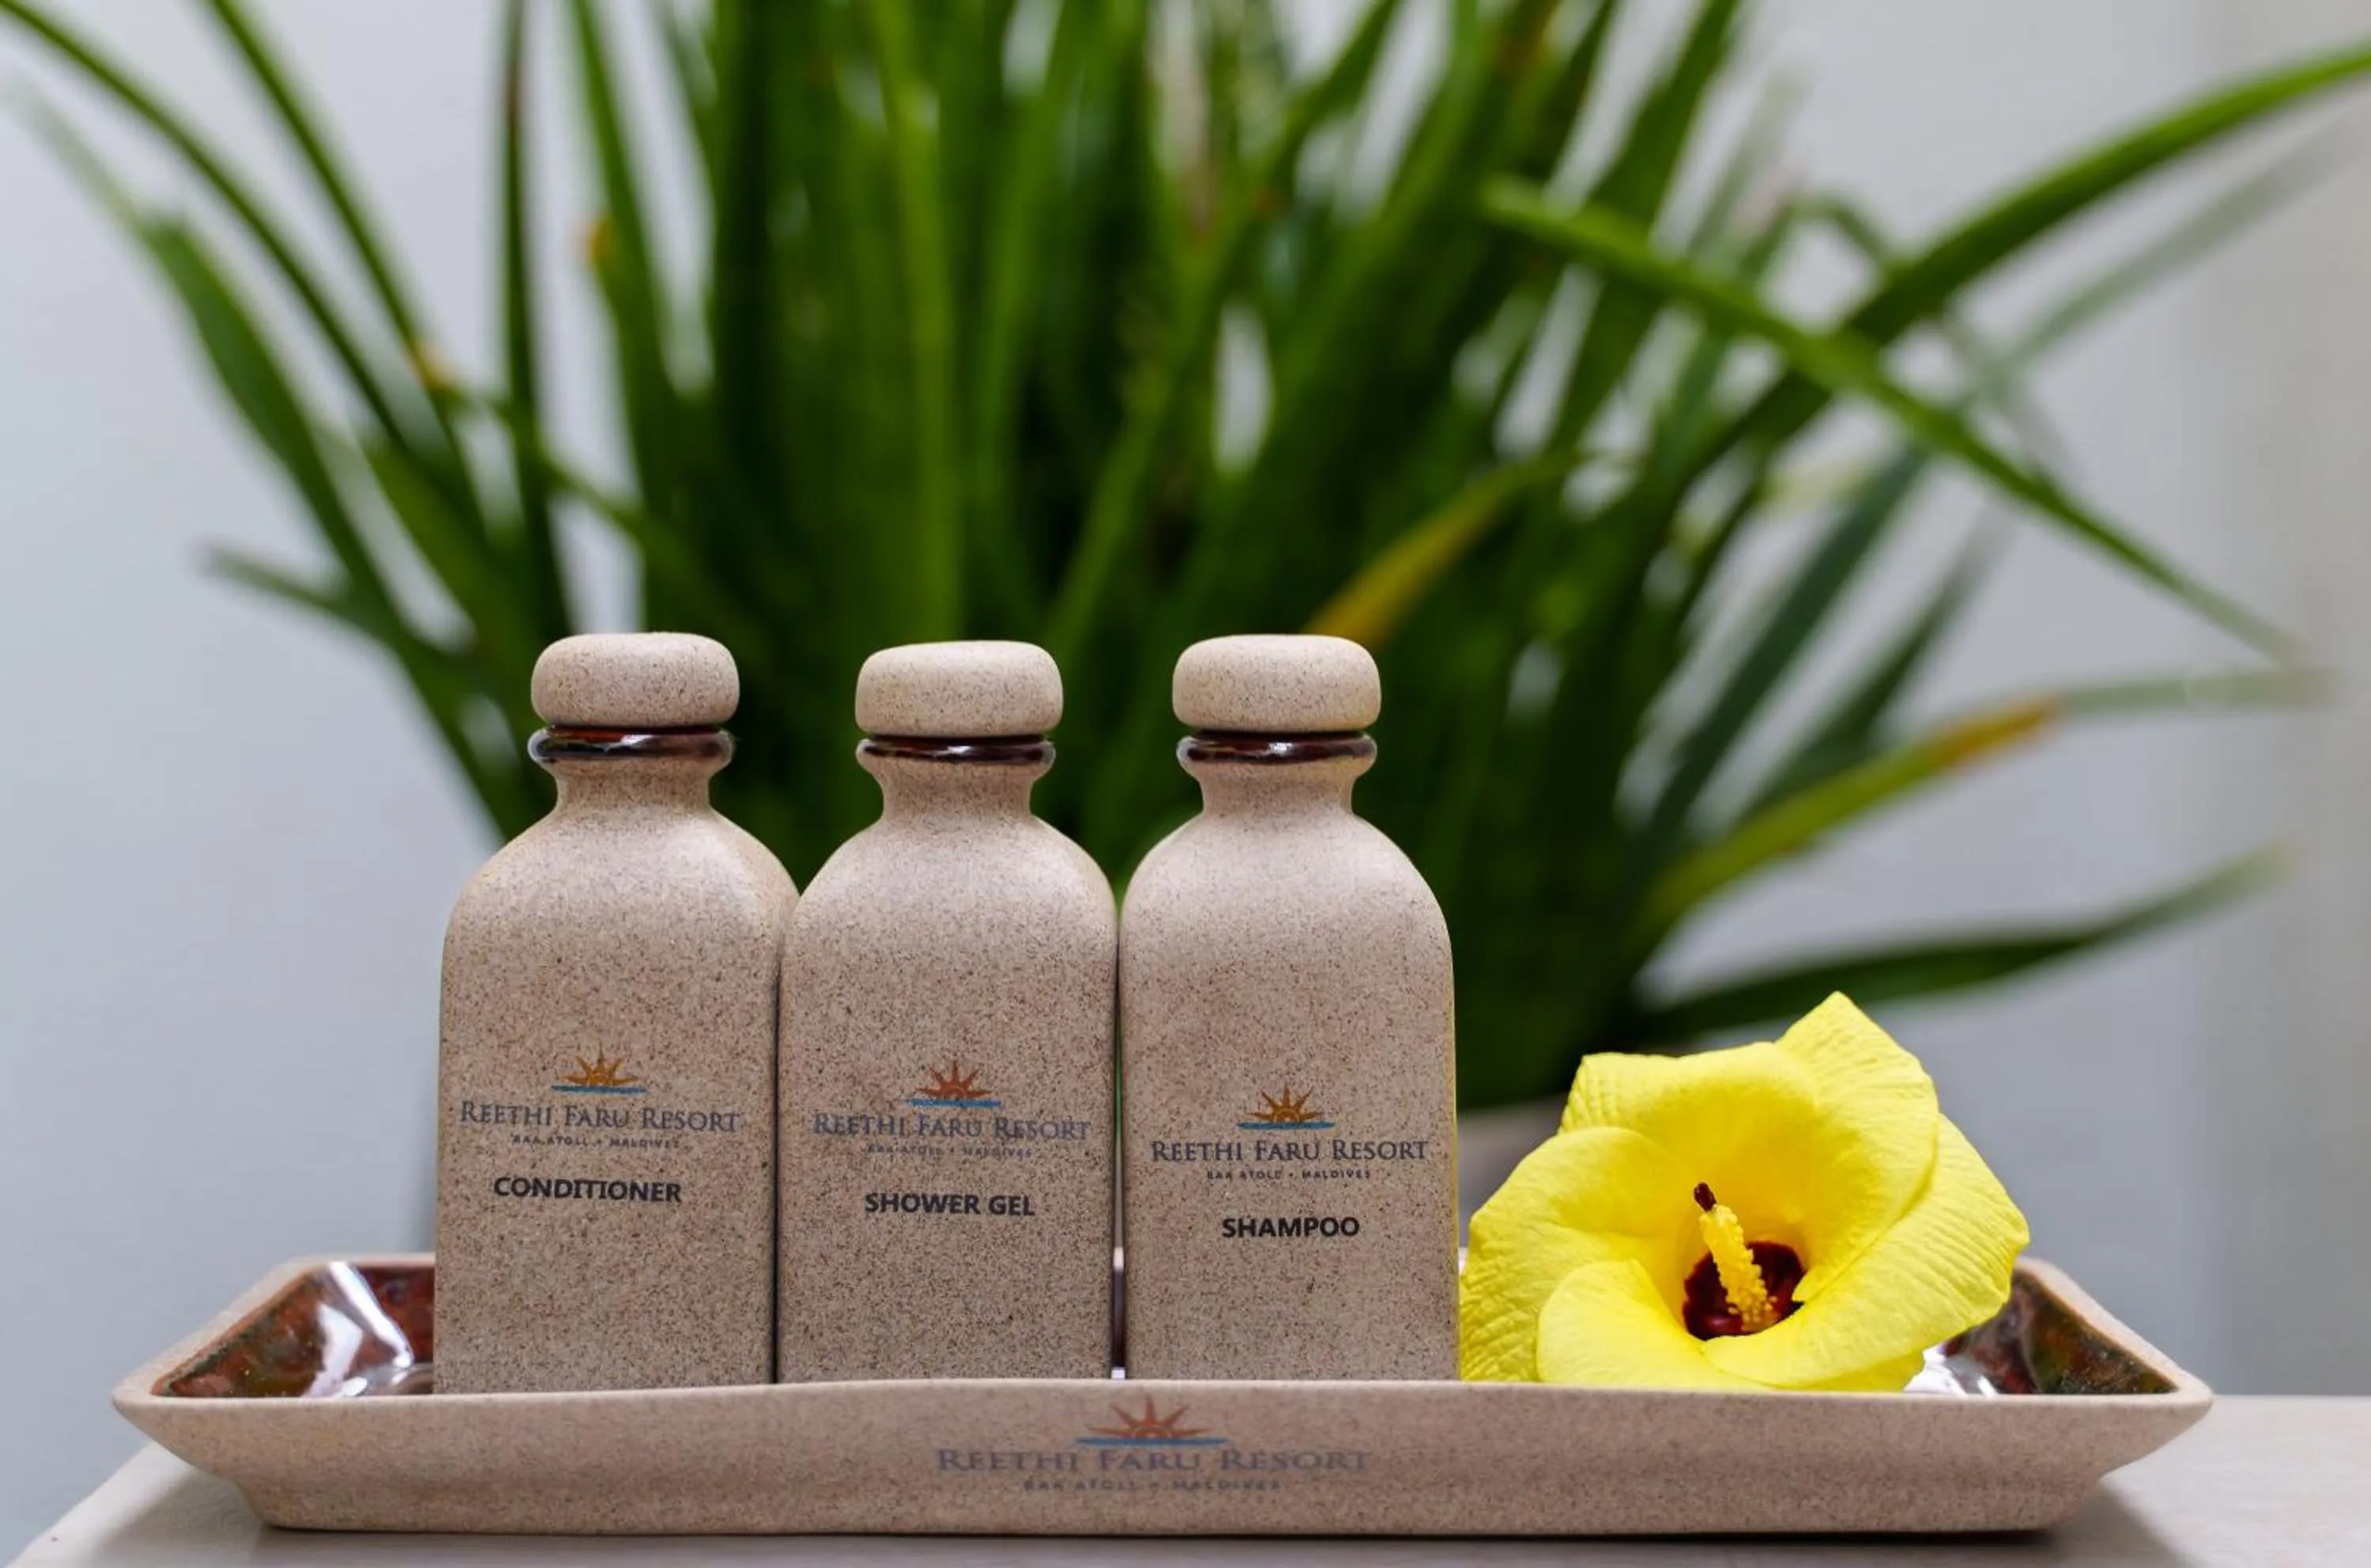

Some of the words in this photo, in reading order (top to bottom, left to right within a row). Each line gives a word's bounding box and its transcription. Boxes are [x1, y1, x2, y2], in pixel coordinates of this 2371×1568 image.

[461, 1100, 552, 1126] REETHI
[564, 1106, 631, 1128] FARU
[642, 1108, 740, 1133] RESORT
[814, 1113, 907, 1136] REETHI
[918, 1114, 982, 1136] FARU
[994, 1117, 1091, 1140] RESORT
[546, 1135, 588, 1147] ATOLL
[1152, 1140, 1243, 1163] REETHI
[1255, 1140, 1320, 1161] FARU
[1333, 1138, 1429, 1160] RESORT
[1302, 1169, 1372, 1180] MALDIVES
[494, 1176, 682, 1203] CONDITIONER
[865, 1193, 981, 1216] SHOWER
[988, 1194, 1035, 1216] GEL
[1222, 1216, 1361, 1238] SHAMPOO
[937, 1449, 1080, 1472] REETHI
[1099, 1448, 1201, 1471] FARU
[1219, 1449, 1370, 1472] RESORT
